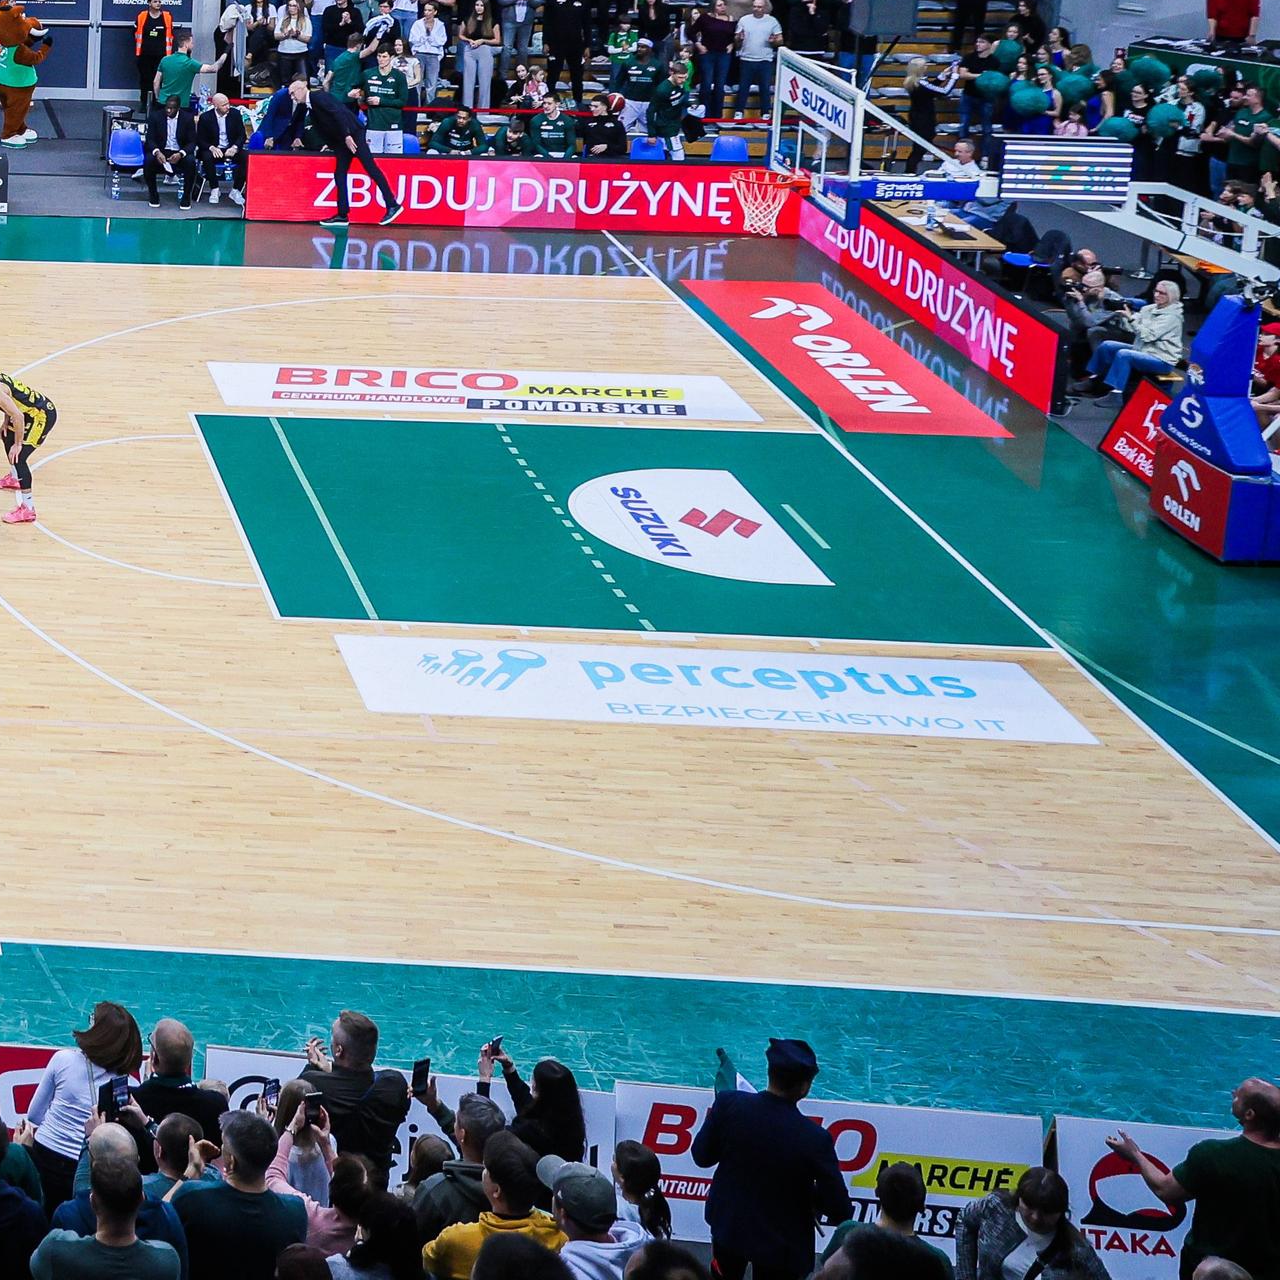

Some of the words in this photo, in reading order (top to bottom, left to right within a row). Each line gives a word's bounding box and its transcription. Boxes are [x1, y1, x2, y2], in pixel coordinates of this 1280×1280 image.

[801, 87, 847, 131] SUZUKI
[313, 172, 498, 213] ZBUDUJ
[511, 171, 735, 226] DRUŻYNĘ
[876, 182, 925, 191] Schelde
[876, 190, 924, 198] Sports
[823, 221, 902, 282] ZBUDUJ
[905, 258, 1018, 379] DRUŻYNĘ
[274, 367, 520, 391] BRICO
[528, 384, 671, 399] MARCHÉ
[791, 333, 933, 414] ORLEN
[279, 390, 364, 401] CENTRUM
[365, 394, 461, 404] HANDLOWE
[483, 399, 677, 415] POMORSKIE
[1112, 437, 1136, 463] Bank
[609, 486, 693, 558] SUZUKI
[1163, 495, 1201, 533] ORLEN
[578, 658, 978, 701] perceptus
[606, 700, 967, 732] BEZPIECZEŃSTWO
[973, 717, 1008, 733] IT
